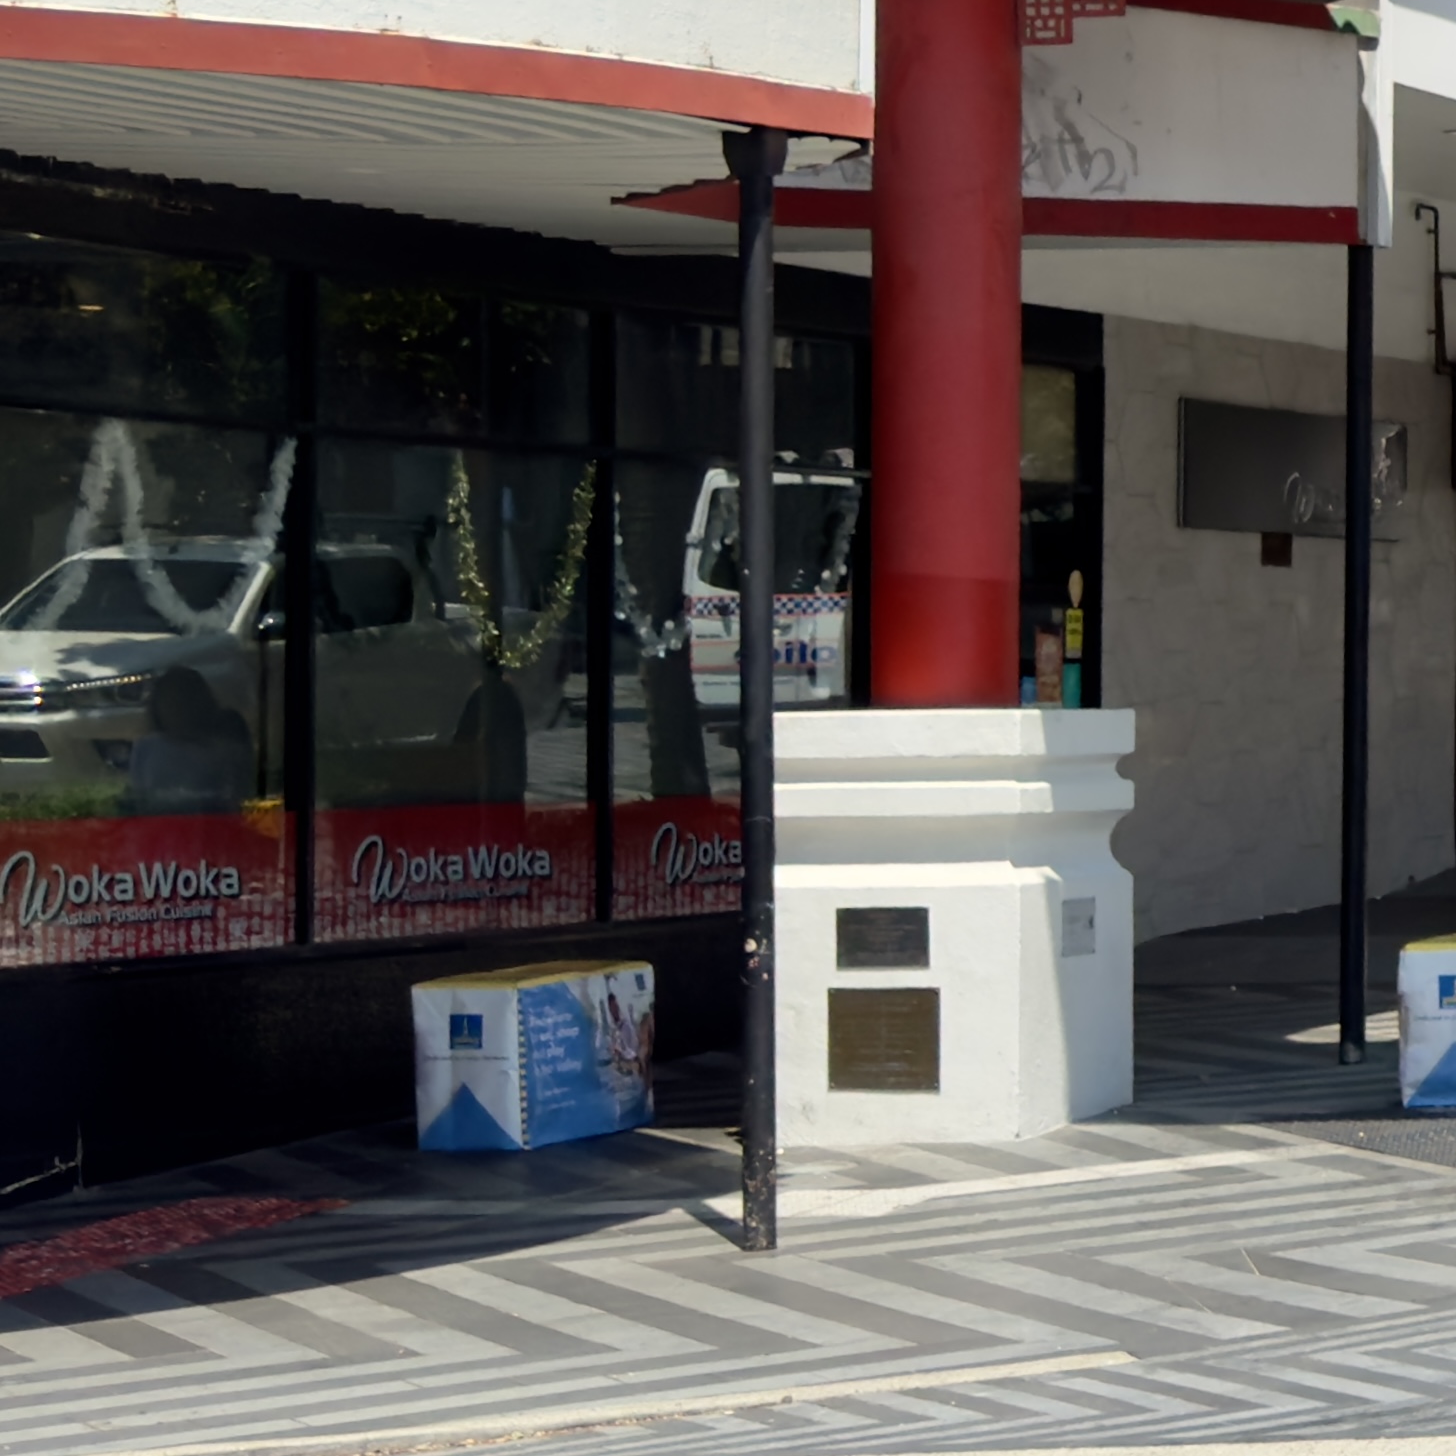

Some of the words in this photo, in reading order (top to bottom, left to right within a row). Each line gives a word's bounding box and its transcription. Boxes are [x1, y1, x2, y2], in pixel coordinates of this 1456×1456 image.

[0, 850, 135, 929] Woka
[138, 859, 242, 901] Woka
[352, 835, 464, 903] Woka
[467, 843, 551, 880] Woka
[59, 907, 101, 926] Asian
[106, 904, 158, 923] Fusion
